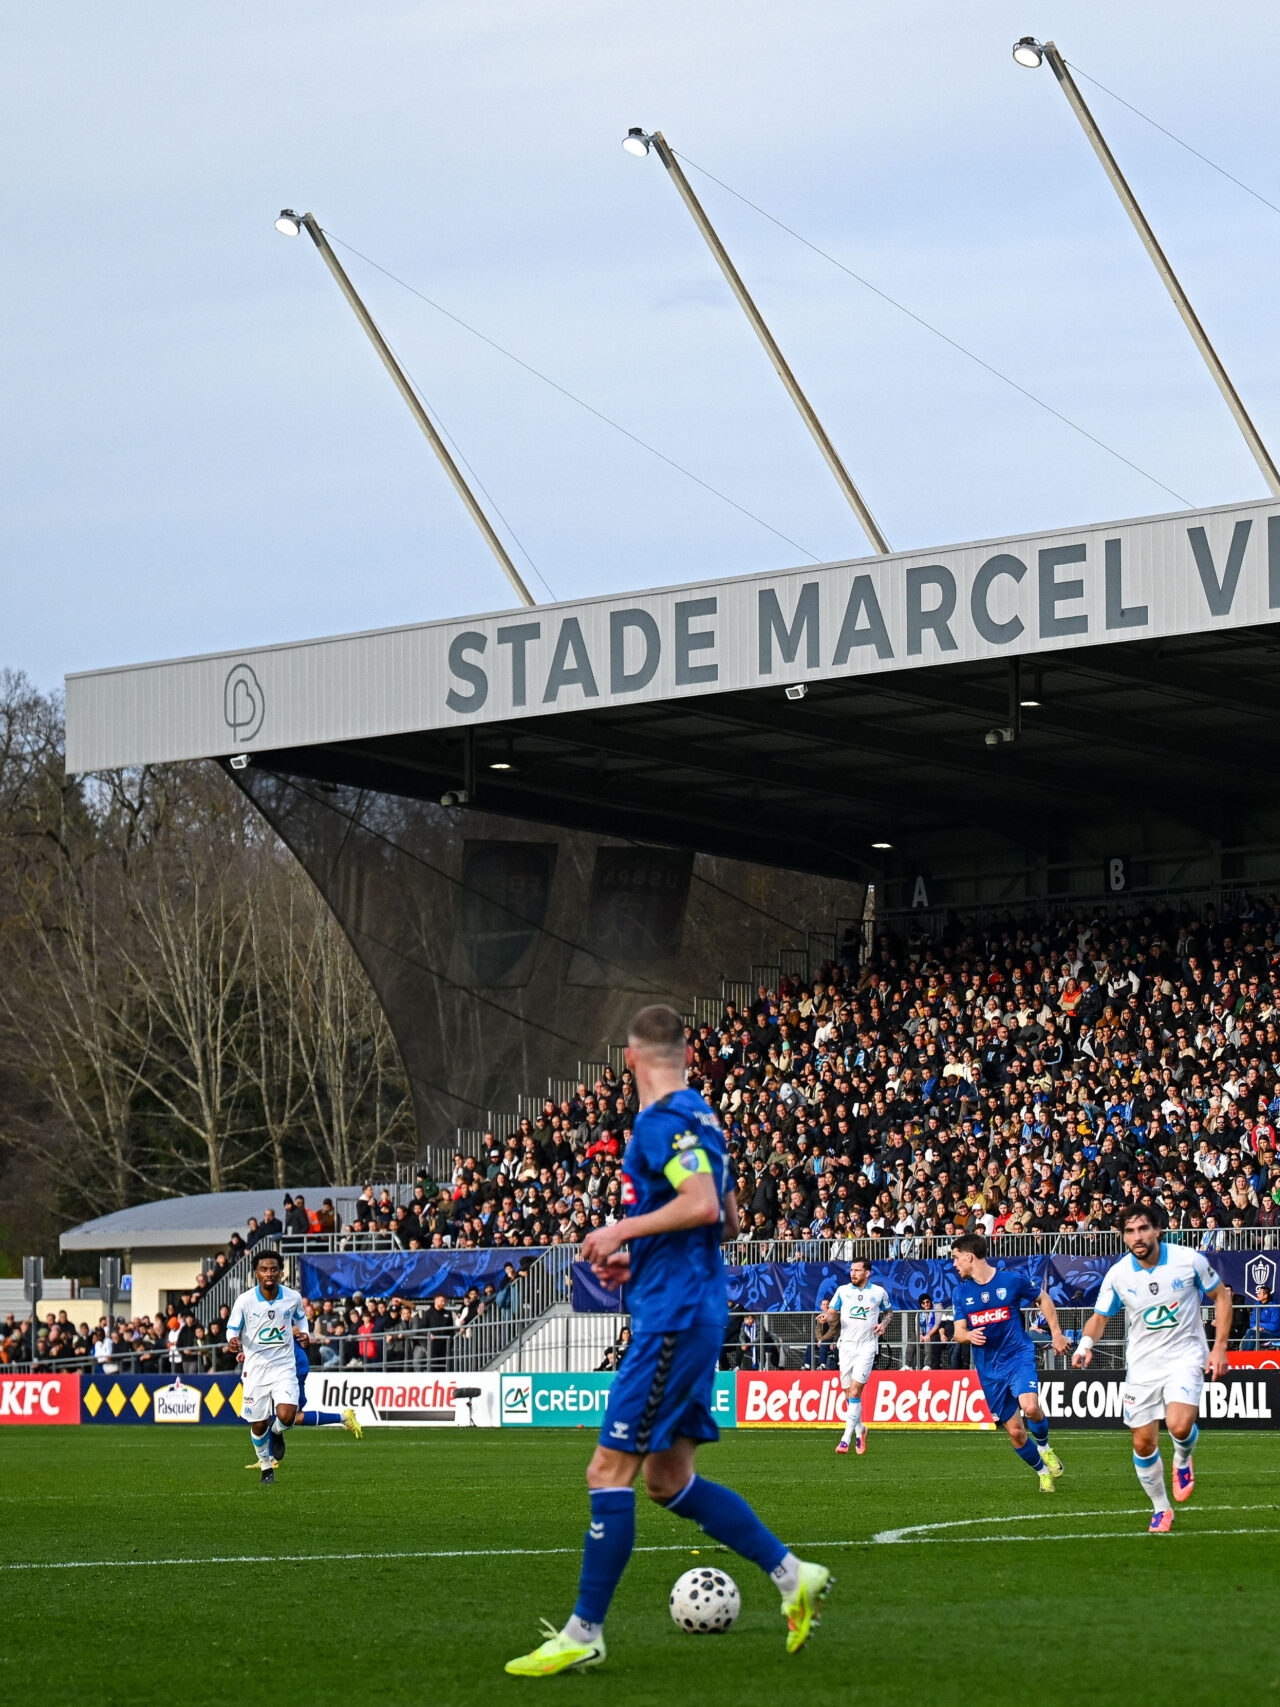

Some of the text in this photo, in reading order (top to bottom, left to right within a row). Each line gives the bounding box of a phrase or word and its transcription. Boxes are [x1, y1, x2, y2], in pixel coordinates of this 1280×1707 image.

[445, 596, 719, 714] STADE
[758, 538, 1149, 676] MARCEL
[1110, 858, 1126, 891] B
[912, 875, 929, 908] A
[970, 1308, 1008, 1326] Betclic
[0, 1380, 61, 1416] KFC
[157, 1396, 196, 1416] Pasquier
[534, 1384, 611, 1412] CRÉDIT
[744, 1377, 849, 1421] Betclic
[872, 1377, 985, 1422] Betclic
